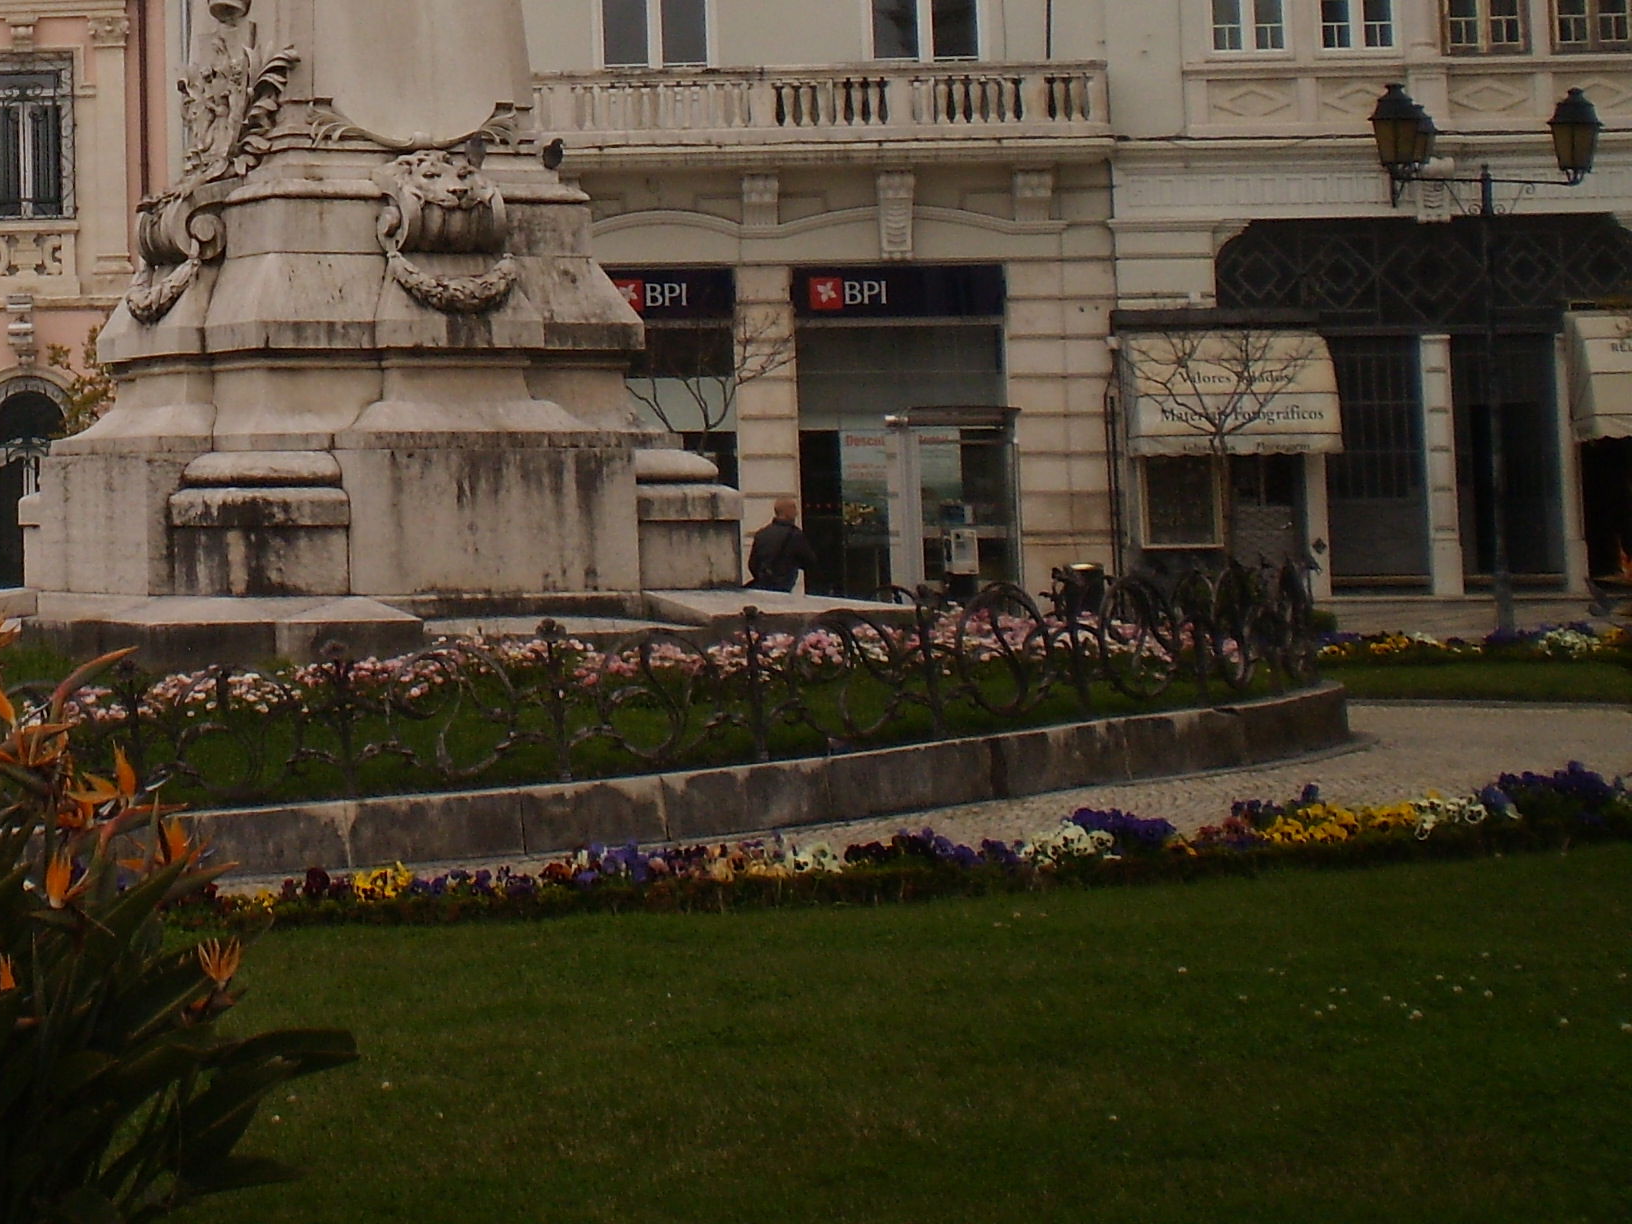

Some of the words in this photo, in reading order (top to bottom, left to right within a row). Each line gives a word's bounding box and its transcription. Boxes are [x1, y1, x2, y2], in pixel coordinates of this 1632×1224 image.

[645, 282, 687, 307] BPI
[843, 280, 887, 305] BPI
[1179, 371, 1231, 384] Valores
[1236, 371, 1291, 384] elados
